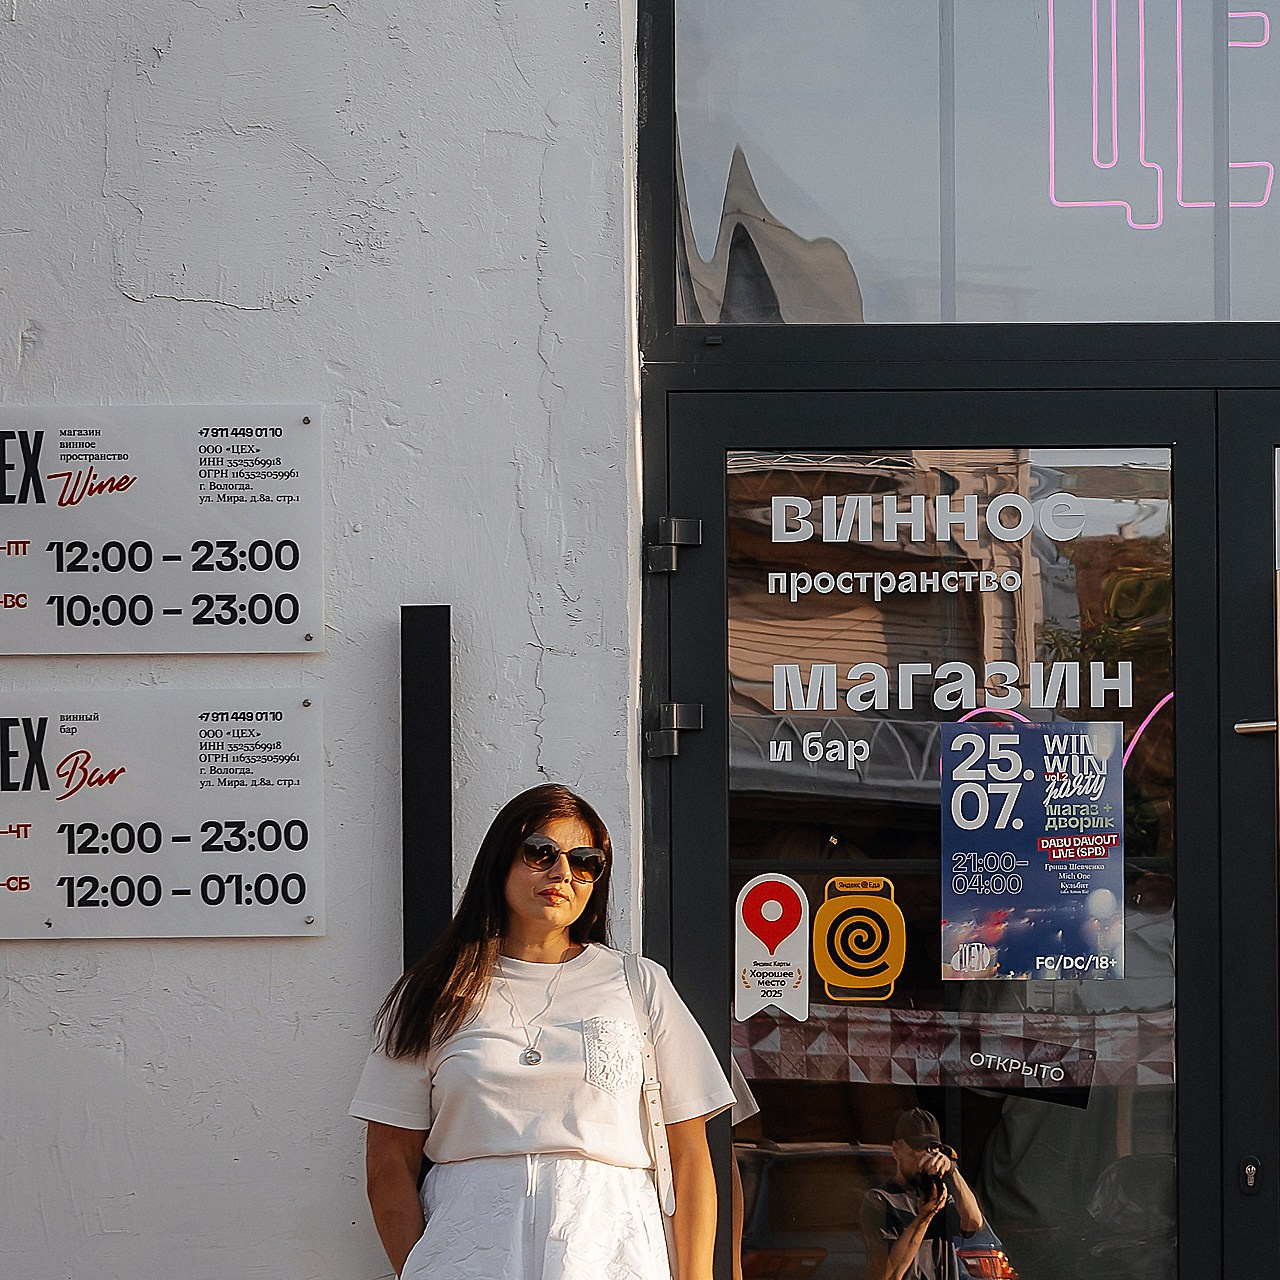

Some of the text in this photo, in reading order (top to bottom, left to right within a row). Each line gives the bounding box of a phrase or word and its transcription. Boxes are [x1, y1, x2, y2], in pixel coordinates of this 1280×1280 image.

[60, 429, 101, 437] магазин
[198, 428, 210, 438] +7
[211, 428, 229, 438] 911
[230, 427, 254, 438] 449
[60, 441, 96, 449] винное
[198, 444, 261, 455] ООО «ЦЕХ»
[60, 453, 129, 463] пространство
[199, 456, 282, 468] ИНН 3525369918
[198, 468, 300, 481] ОГРН 1163525059961
[47, 465, 137, 507] Wine
[199, 483, 206, 491] г.
[198, 495, 214, 505] ул.
[770, 492, 1087, 544] винное
[46, 540, 153, 572] 12:00
[190, 539, 300, 572] 23:00
[767, 568, 1022, 602] пространство
[46, 594, 153, 627] 10:00
[191, 593, 300, 626] 23:00
[771, 661, 1134, 712] магазин
[60, 712, 100, 722] винный
[198, 712, 210, 722] +7
[211, 712, 229, 722] 911
[230, 711, 254, 722] 449
[60, 724, 78, 736] бар
[199, 728, 262, 739] ООО «ЦЕХ»
[199, 740, 282, 752] ИНН 3525369918
[768, 731, 871, 770] и бар
[1043, 734, 1099, 755] WIN
[198, 752, 300, 765] ОГРН 1163525059961
[950, 733, 1035, 781] 25.
[199, 767, 206, 775] г.
[1043, 755, 1108, 777] WIN
[56, 749, 126, 801] Bar
[1044, 773, 1069, 782] vol.2
[199, 780, 215, 790] ул.
[1042, 770, 1106, 808] party
[950, 782, 1024, 830] 07.
[1045, 804, 1099, 816] магаз
[1044, 817, 1115, 833] дворик
[56, 822, 162, 855] 12:00
[200, 819, 309, 853] 23:00
[1073, 834, 1118, 847] DAVOUT
[1052, 845, 1106, 859] LIVE (SPB)
[56, 874, 162, 908] 12:00
[200, 872, 307, 906] 01:00
[951, 874, 1023, 895] 04:00
[749, 969, 794, 979] Хорошее
[760, 989, 783, 998] 2025
[969, 1052, 1065, 1082] ОТКРЫТО
